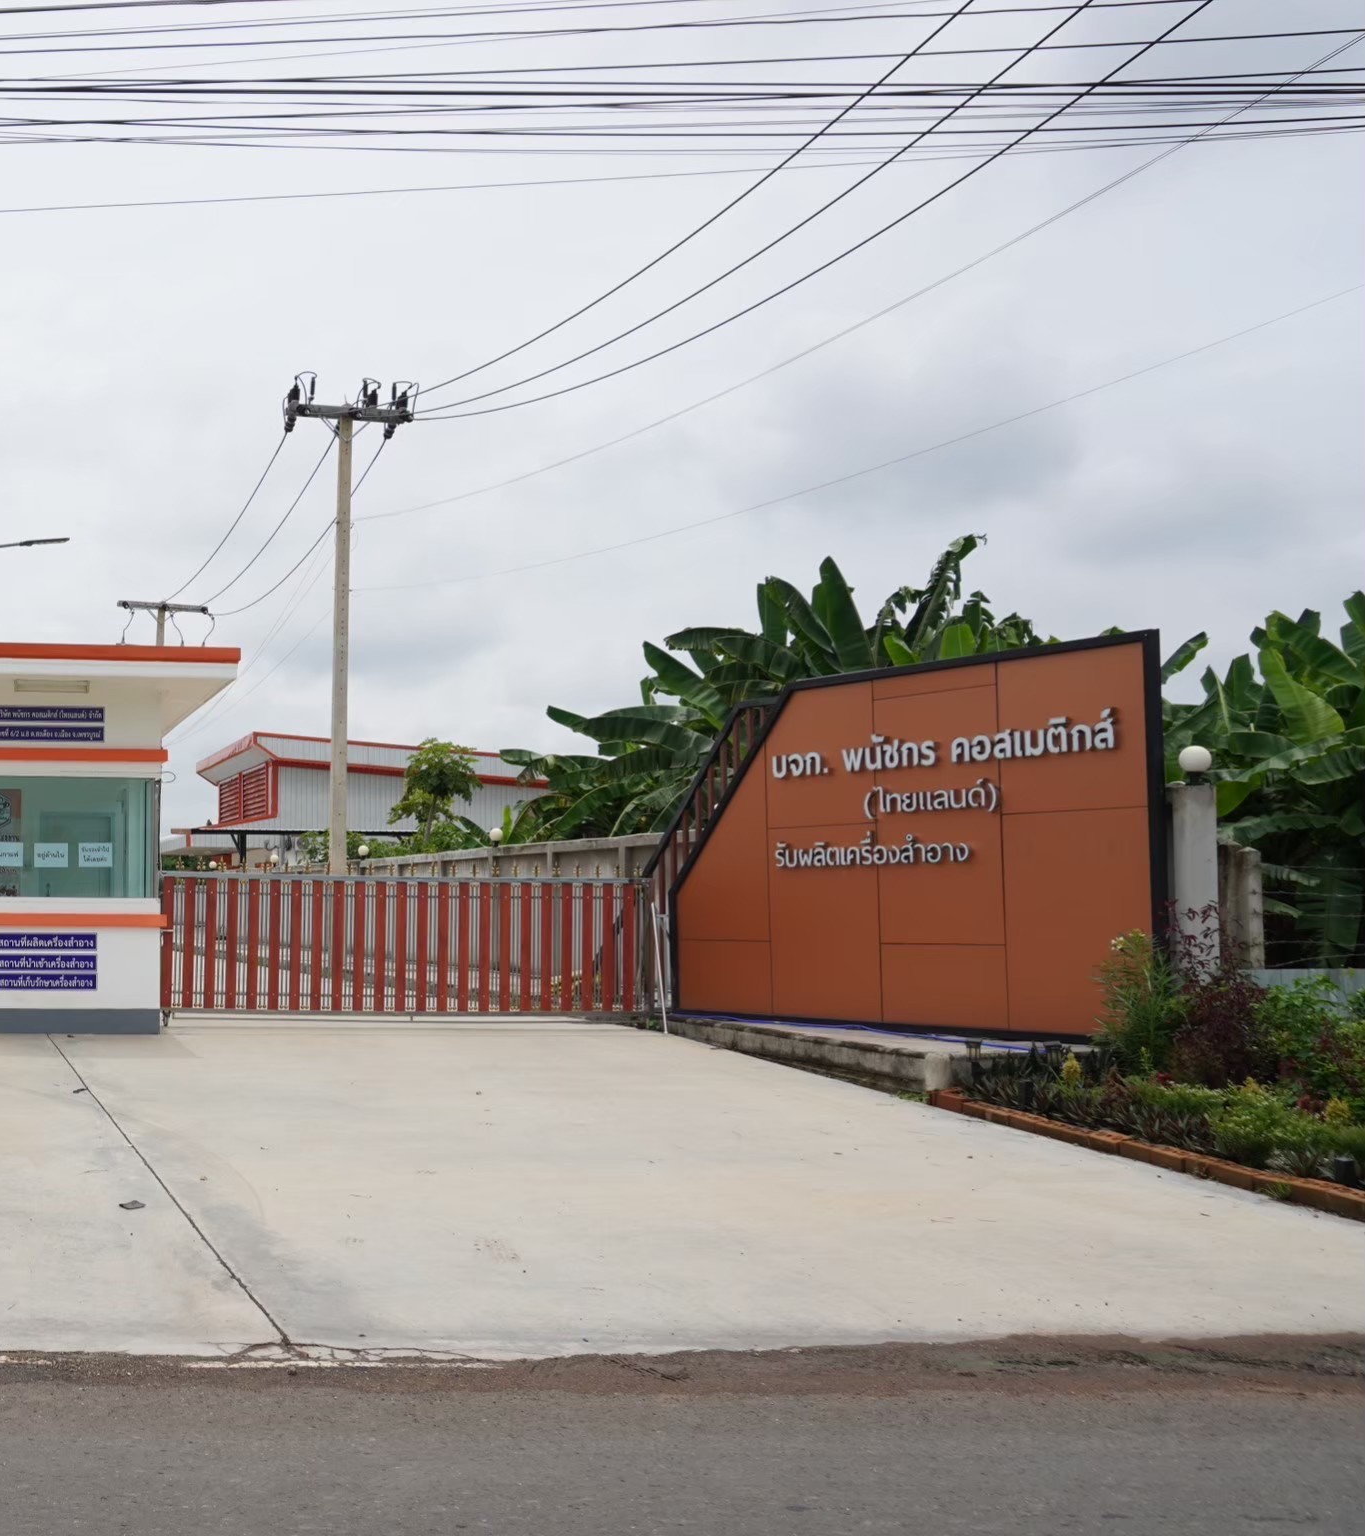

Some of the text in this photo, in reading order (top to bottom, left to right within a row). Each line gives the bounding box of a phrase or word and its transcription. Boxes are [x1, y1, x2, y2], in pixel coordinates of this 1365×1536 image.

[772, 706, 1118, 780] บจก. พนัชกร คอสเมติกส์
[863, 778, 999, 819] (ไทยแลนด์)
[774, 830, 971, 869] รับผลิตเครื่องสำอาง
[0, 975, 93, 988] สถานที่เก็บรักษาเครื่องสำอาง
